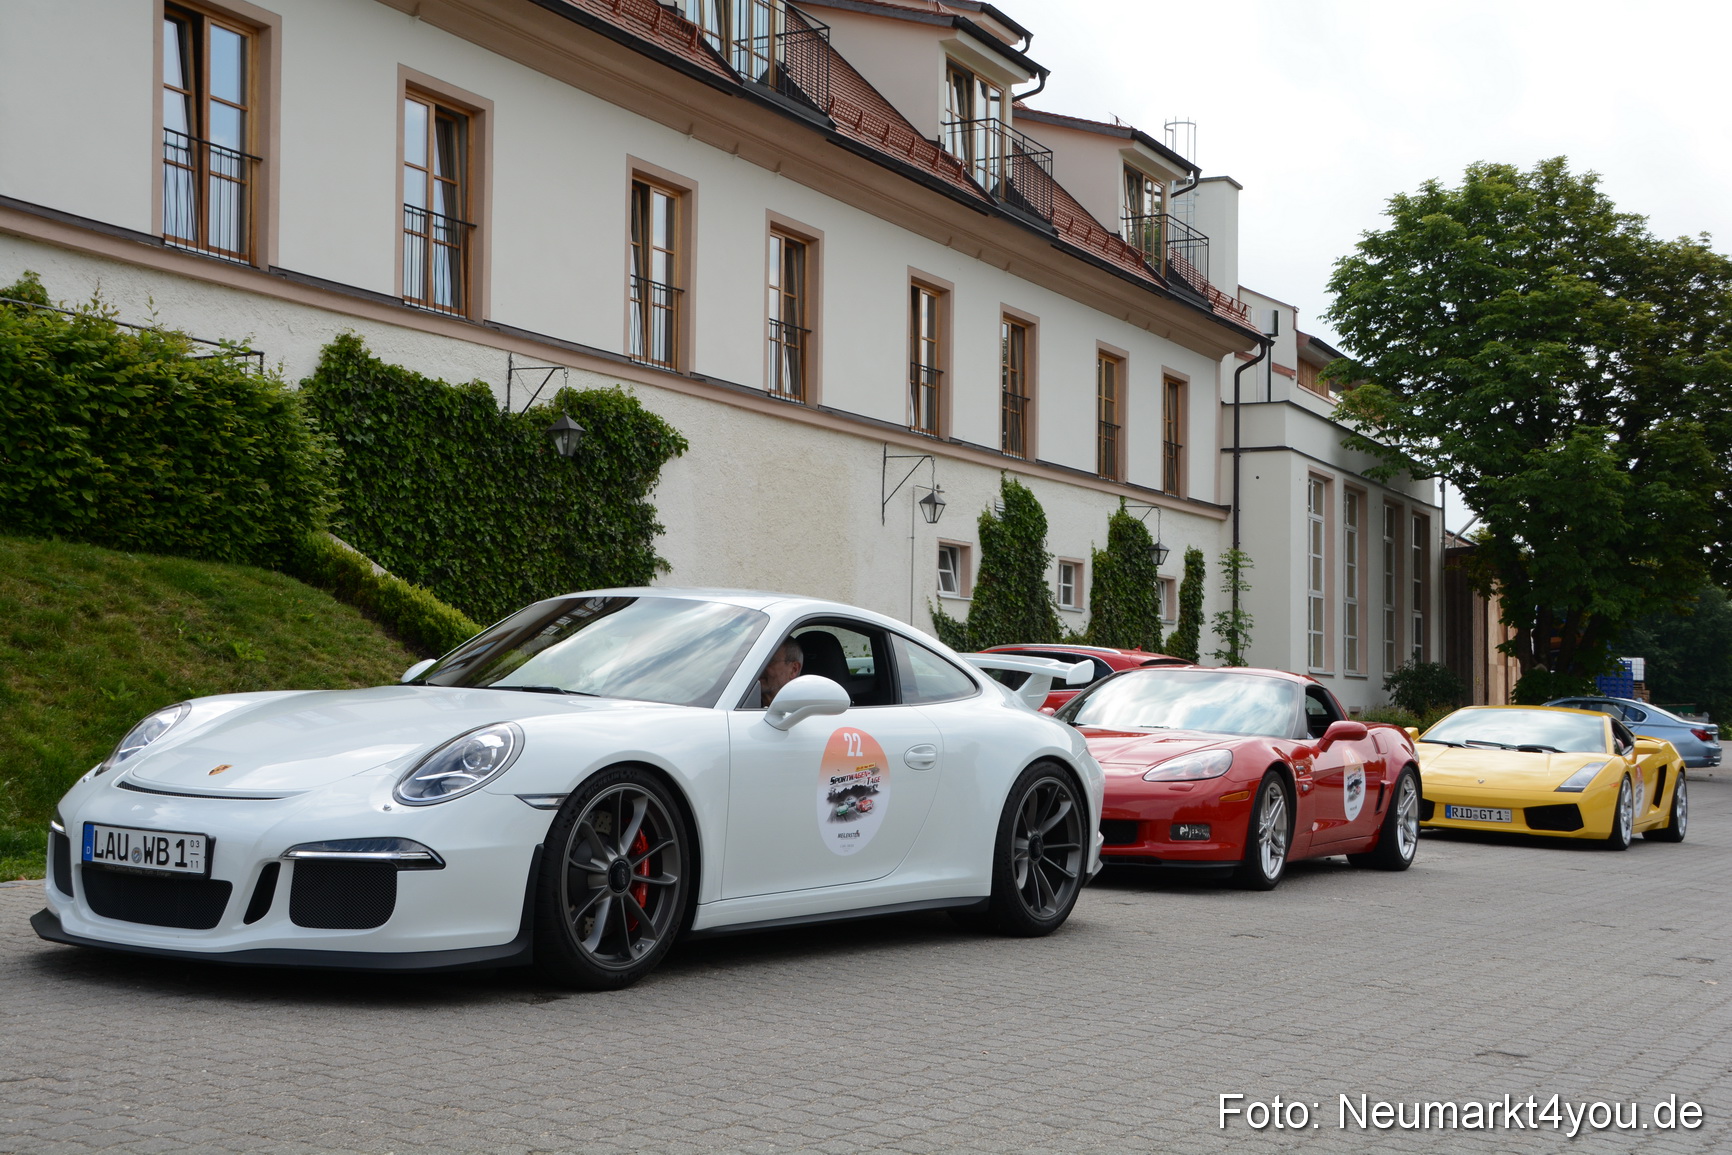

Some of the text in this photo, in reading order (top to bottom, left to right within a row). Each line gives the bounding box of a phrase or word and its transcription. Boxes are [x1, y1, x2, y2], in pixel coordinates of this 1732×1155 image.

[843, 732, 863, 757] 22
[1452, 807, 1472, 819] RID
[1480, 809, 1494, 820] GT
[1496, 810, 1503, 821] 1
[94, 829, 188, 868] LAU WB 1
